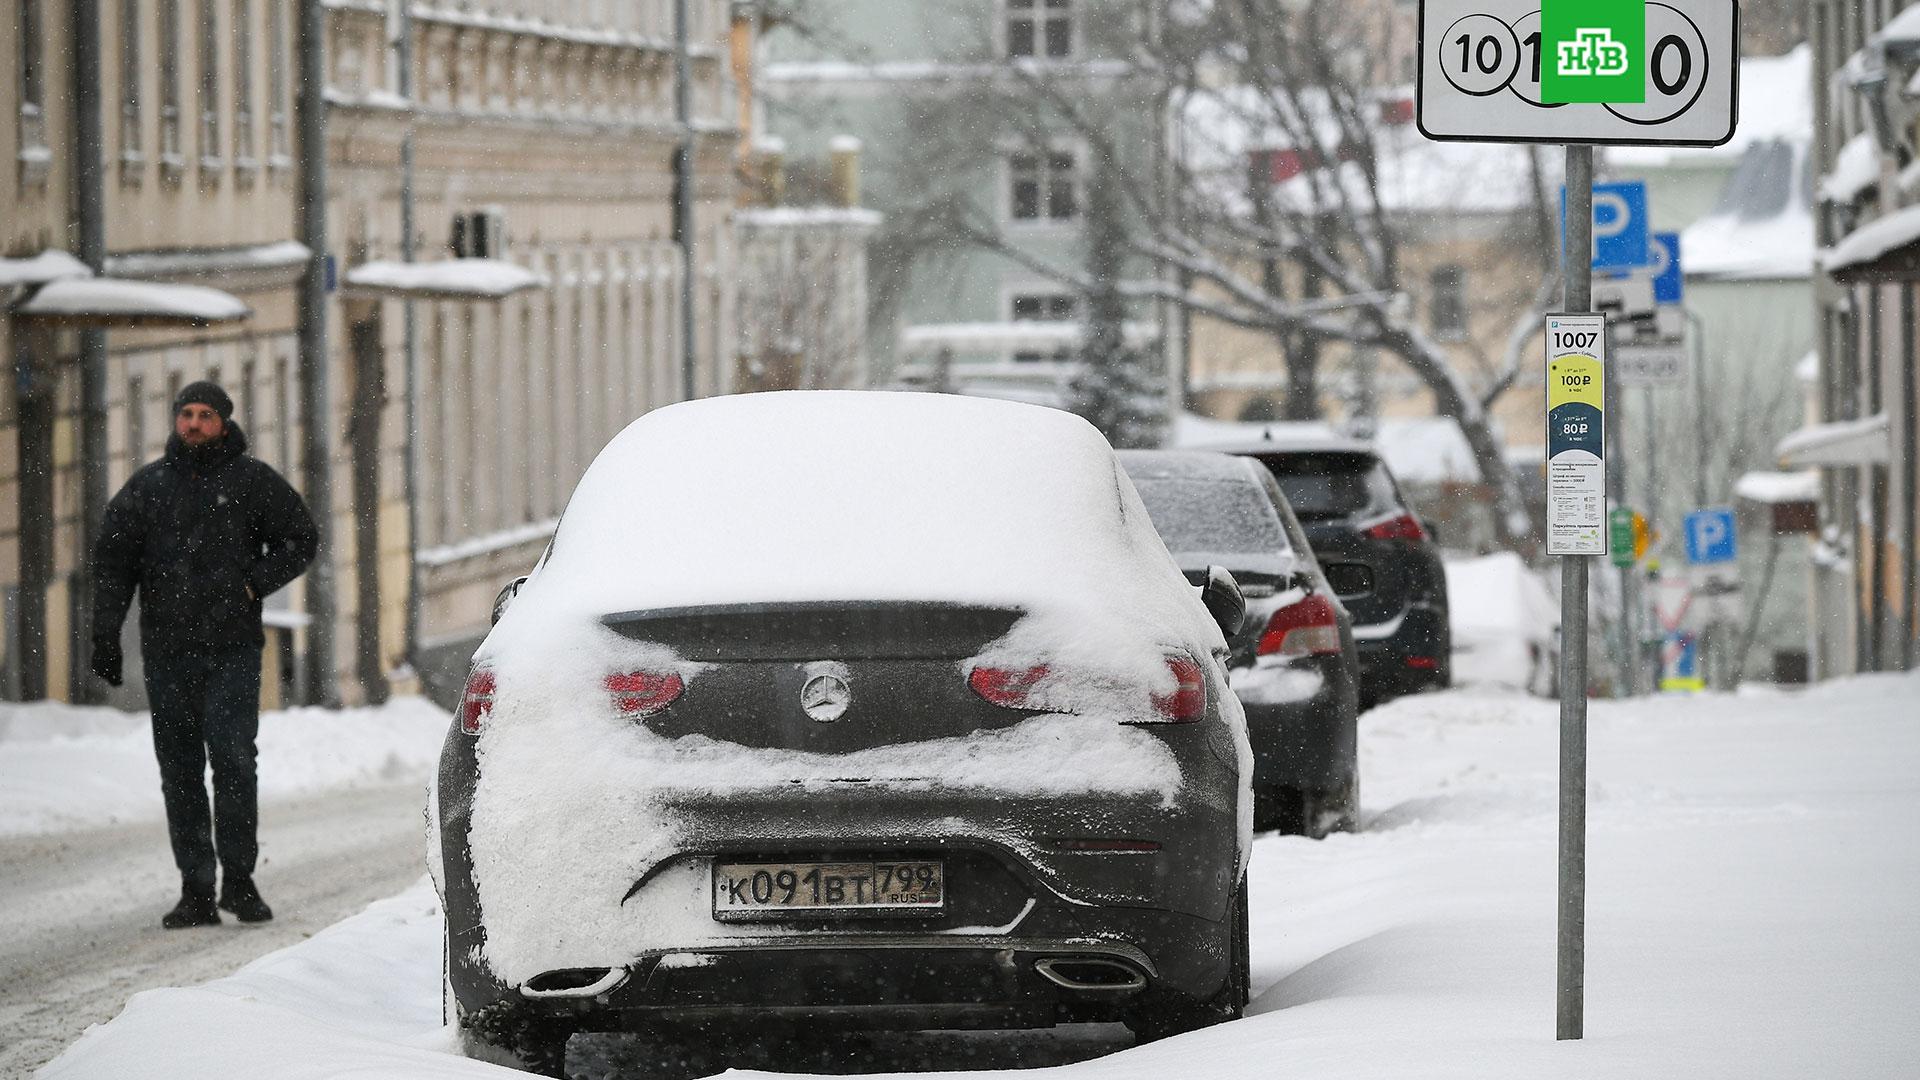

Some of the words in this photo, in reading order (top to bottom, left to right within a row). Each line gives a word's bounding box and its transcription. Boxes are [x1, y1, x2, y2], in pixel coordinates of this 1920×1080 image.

[1455, 32, 1502, 75] 10
[1522, 31, 1541, 83] 1
[1554, 332, 1598, 348] 1007
[1696, 514, 1726, 560] P
[878, 865, 934, 895] 799
[891, 893, 918, 904] RUS
